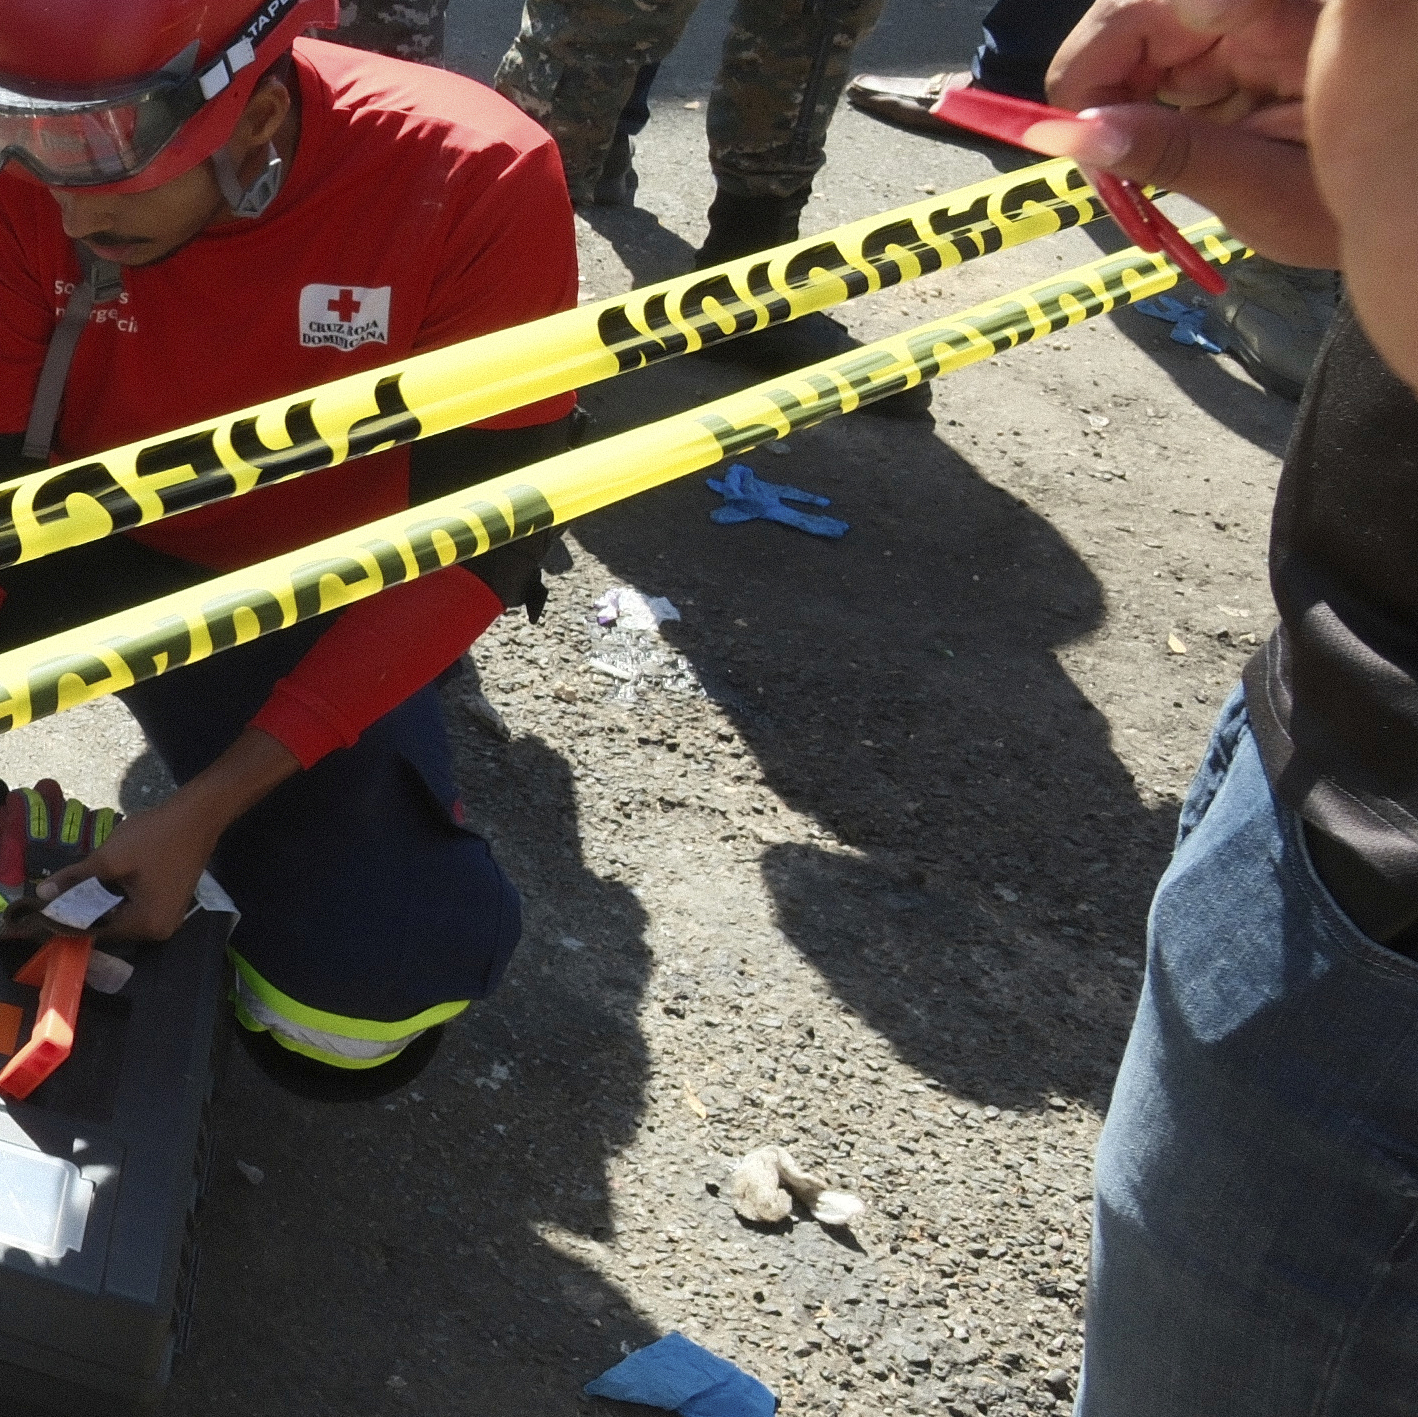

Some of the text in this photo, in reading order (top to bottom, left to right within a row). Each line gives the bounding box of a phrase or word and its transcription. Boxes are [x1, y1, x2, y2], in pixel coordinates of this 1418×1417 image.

[309, 320, 379, 336] CRUZ ROJA
[302, 331, 385, 349] DOMINICANA
